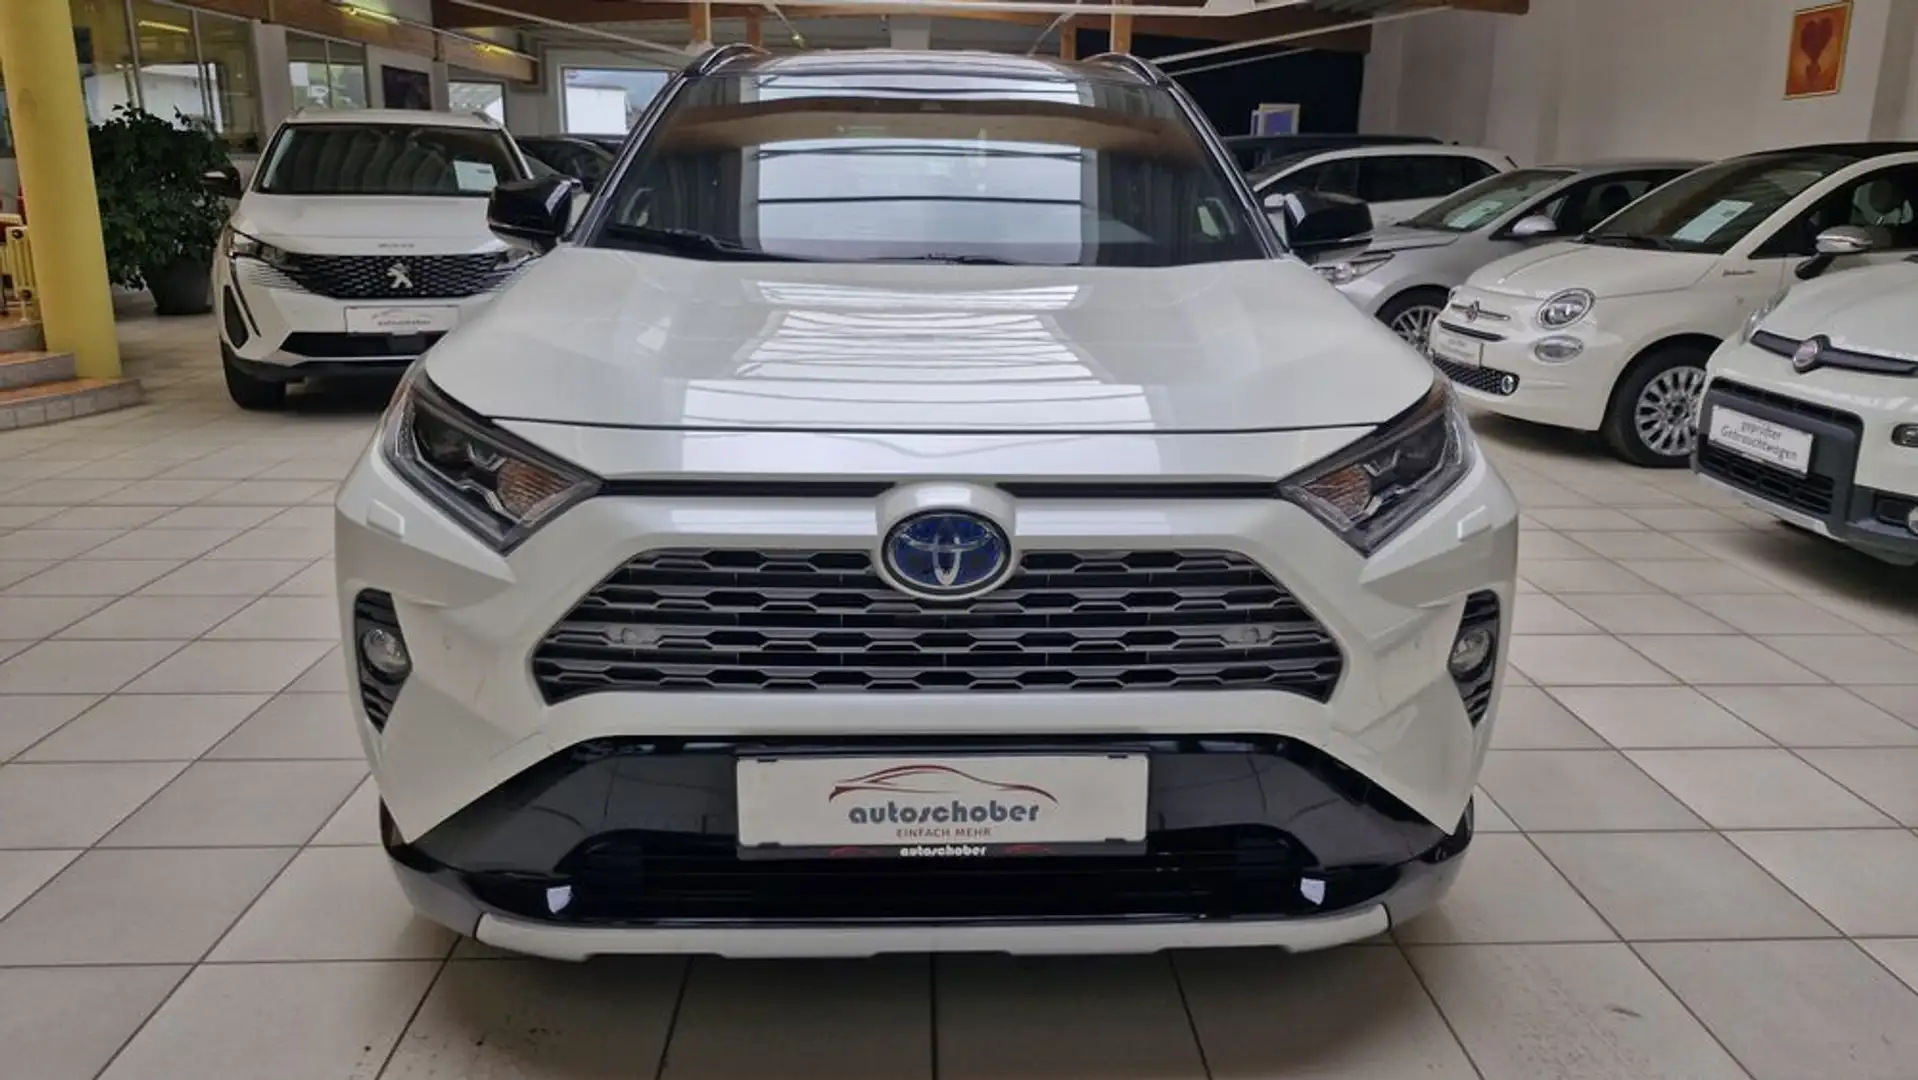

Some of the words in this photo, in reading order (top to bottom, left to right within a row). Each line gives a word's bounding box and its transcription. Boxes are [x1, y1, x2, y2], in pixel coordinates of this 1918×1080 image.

[849, 800, 1040, 825] autoschober
[896, 827, 949, 839] EINFACH
[955, 827, 991, 838] MEHR
[900, 844, 987, 857] autoschober
